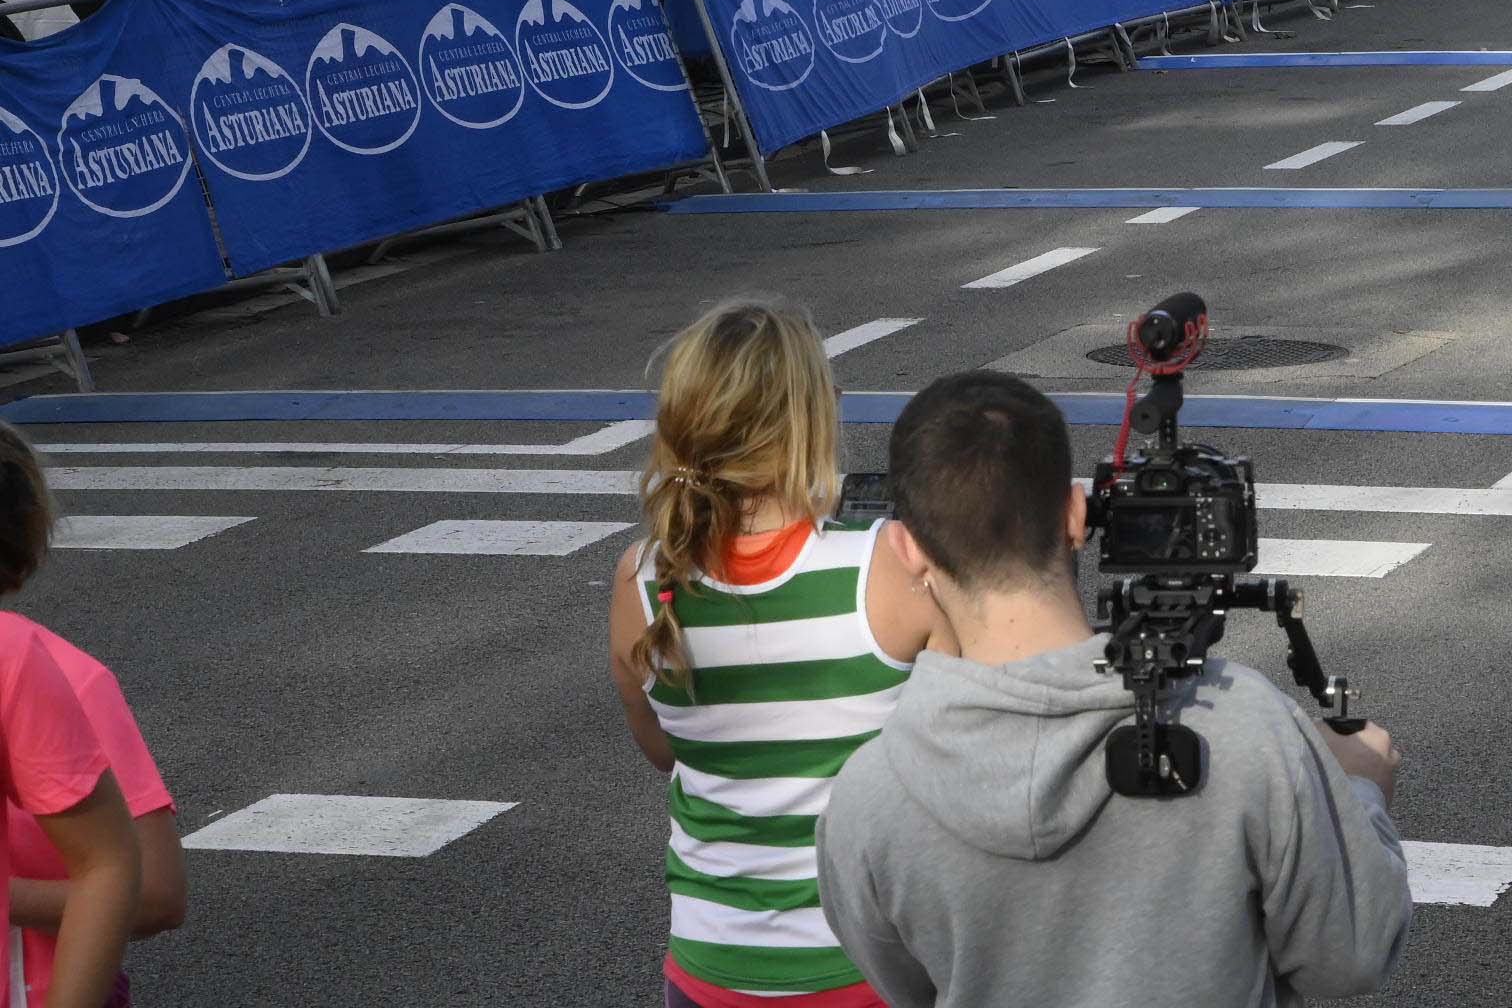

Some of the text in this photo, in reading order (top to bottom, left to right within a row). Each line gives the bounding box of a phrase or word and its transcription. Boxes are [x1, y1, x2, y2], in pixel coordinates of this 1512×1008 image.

[429, 53, 521, 103] ASTURIANA
[523, 38, 609, 84] ASTURIANA
[213, 84, 290, 109] CENTRAL LECHERA
[316, 78, 417, 128] ASTURIANA
[202, 100, 307, 154] ASTURIANA
